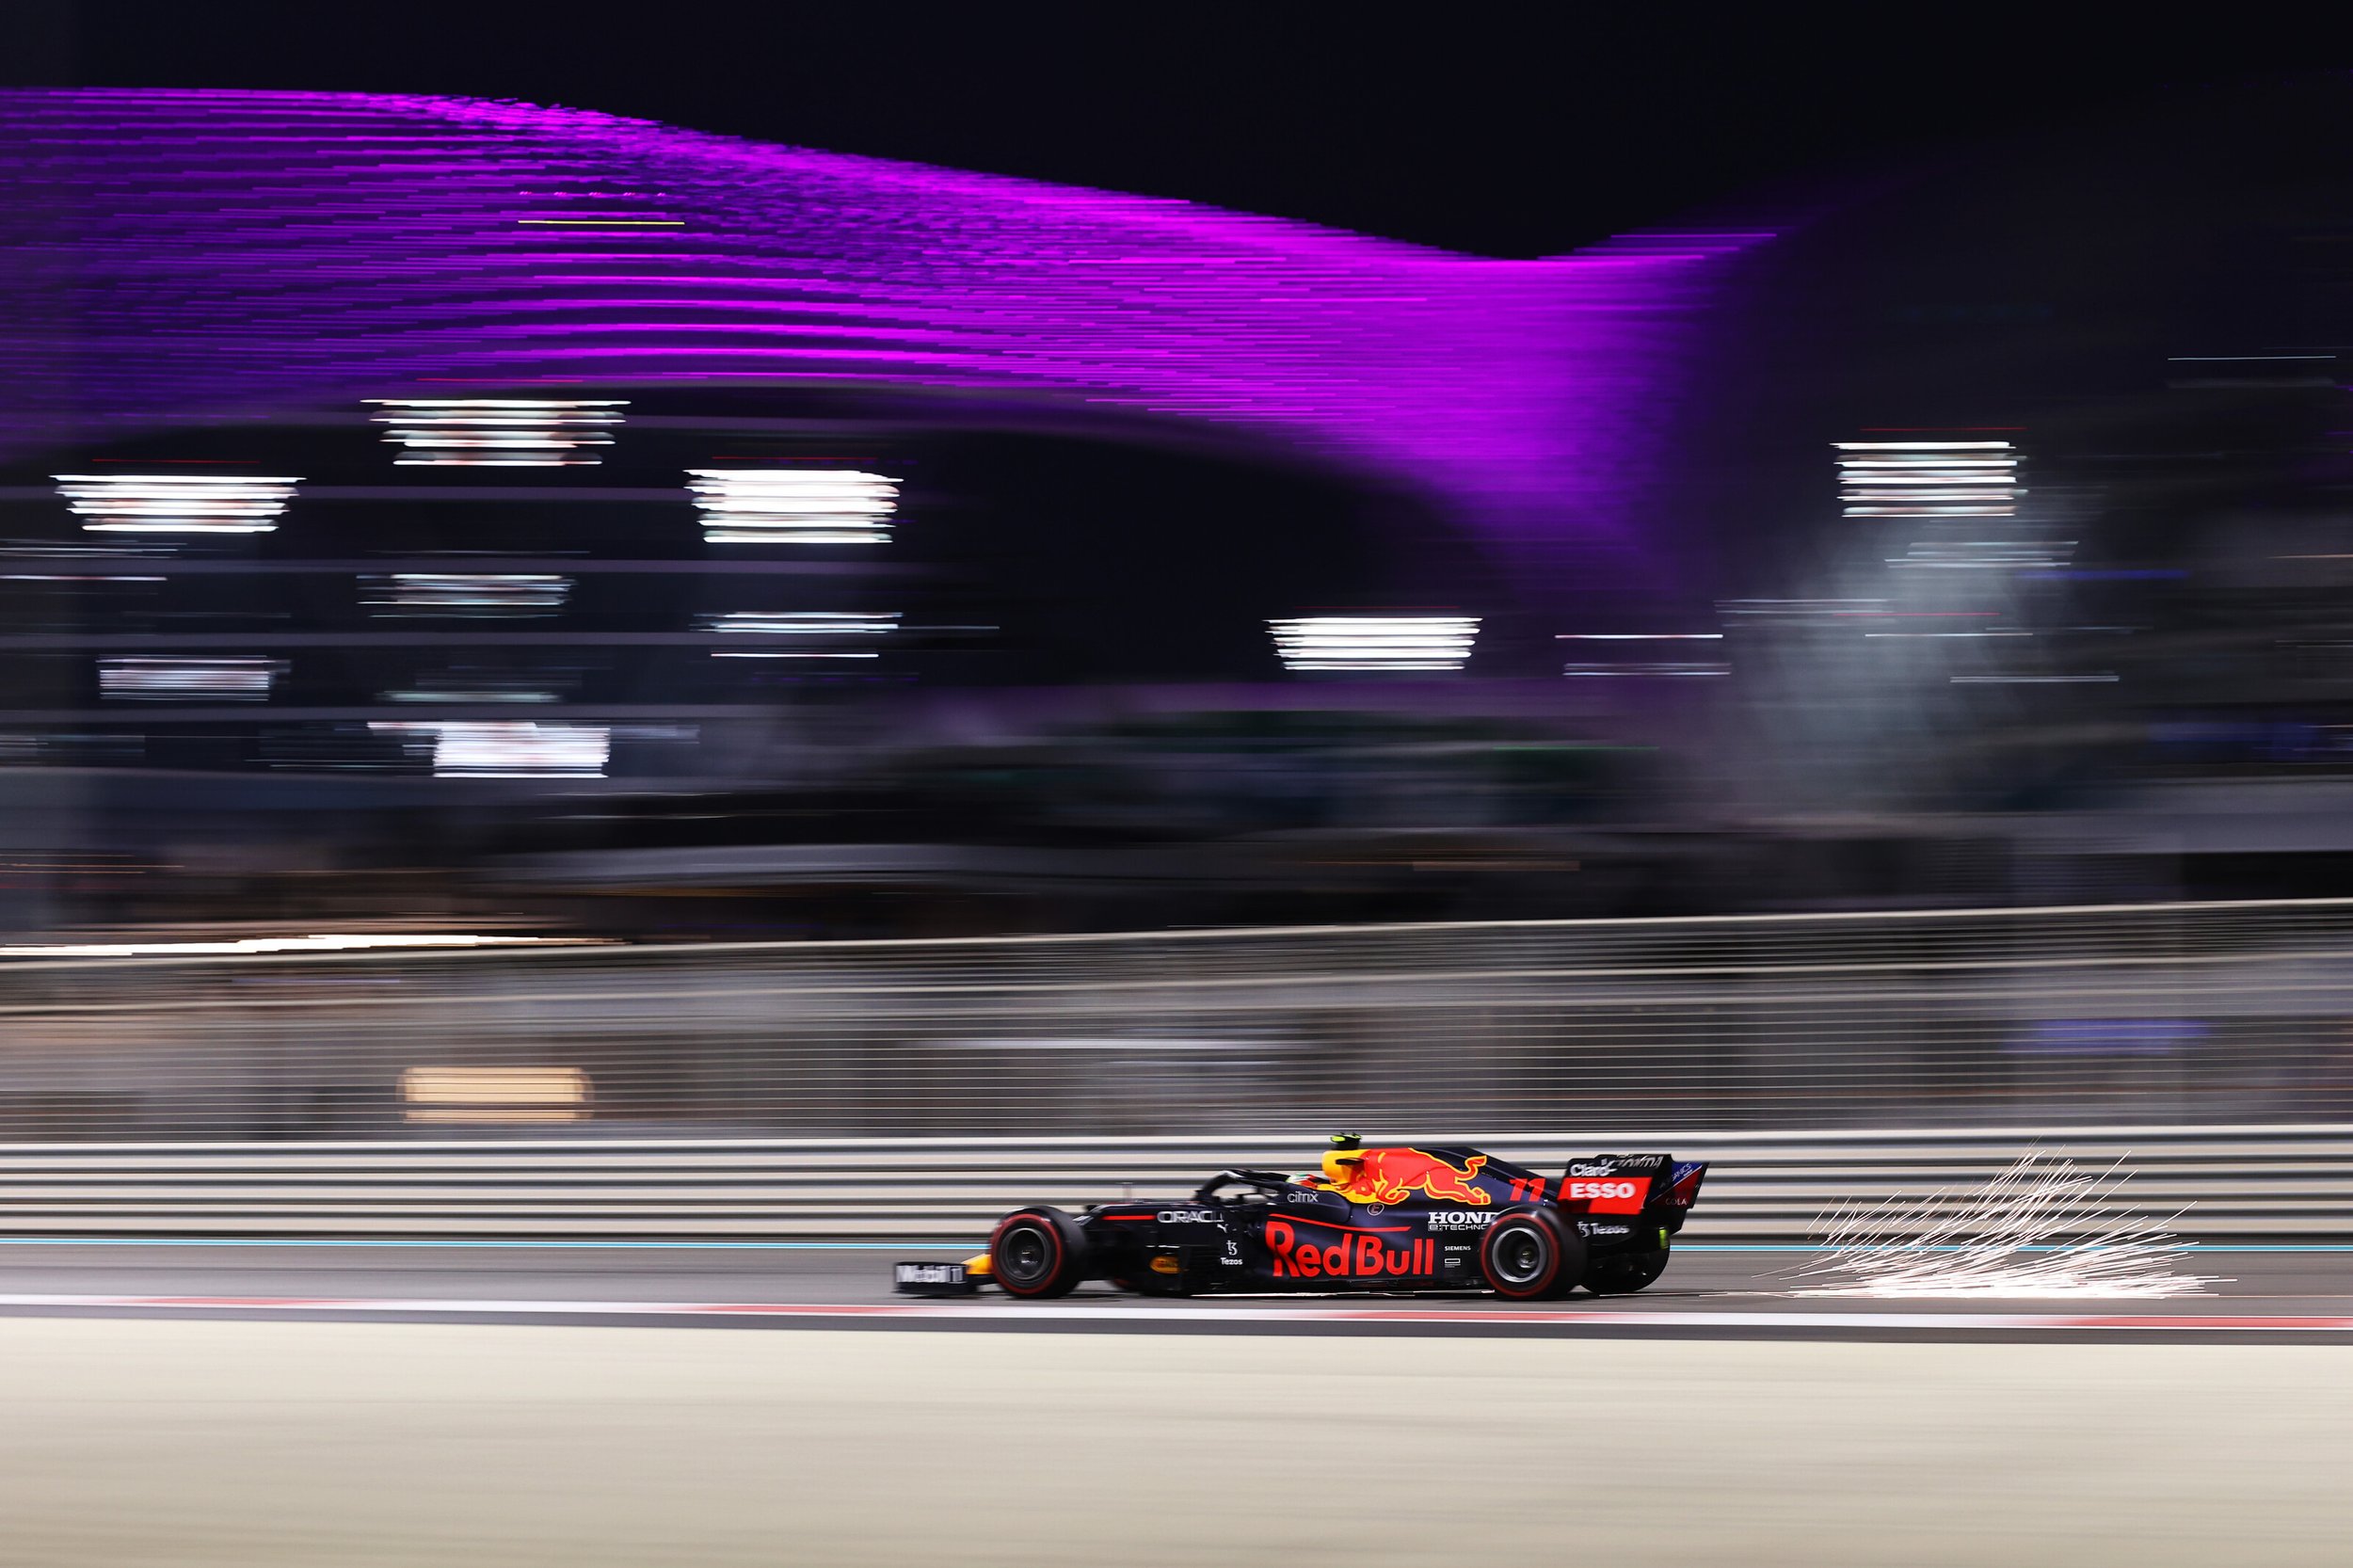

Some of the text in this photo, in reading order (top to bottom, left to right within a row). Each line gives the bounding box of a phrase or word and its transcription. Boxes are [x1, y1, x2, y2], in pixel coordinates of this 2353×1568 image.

[1570, 1159, 1618, 1176] Claro
[1510, 1178, 1546, 1202] 11
[1570, 1182, 1637, 1199] ESSO
[1287, 1191, 1319, 1203] citrix
[1157, 1210, 1225, 1223] ORACL
[1428, 1211, 1500, 1224] HOND
[1220, 1256, 1243, 1265] Tezos
